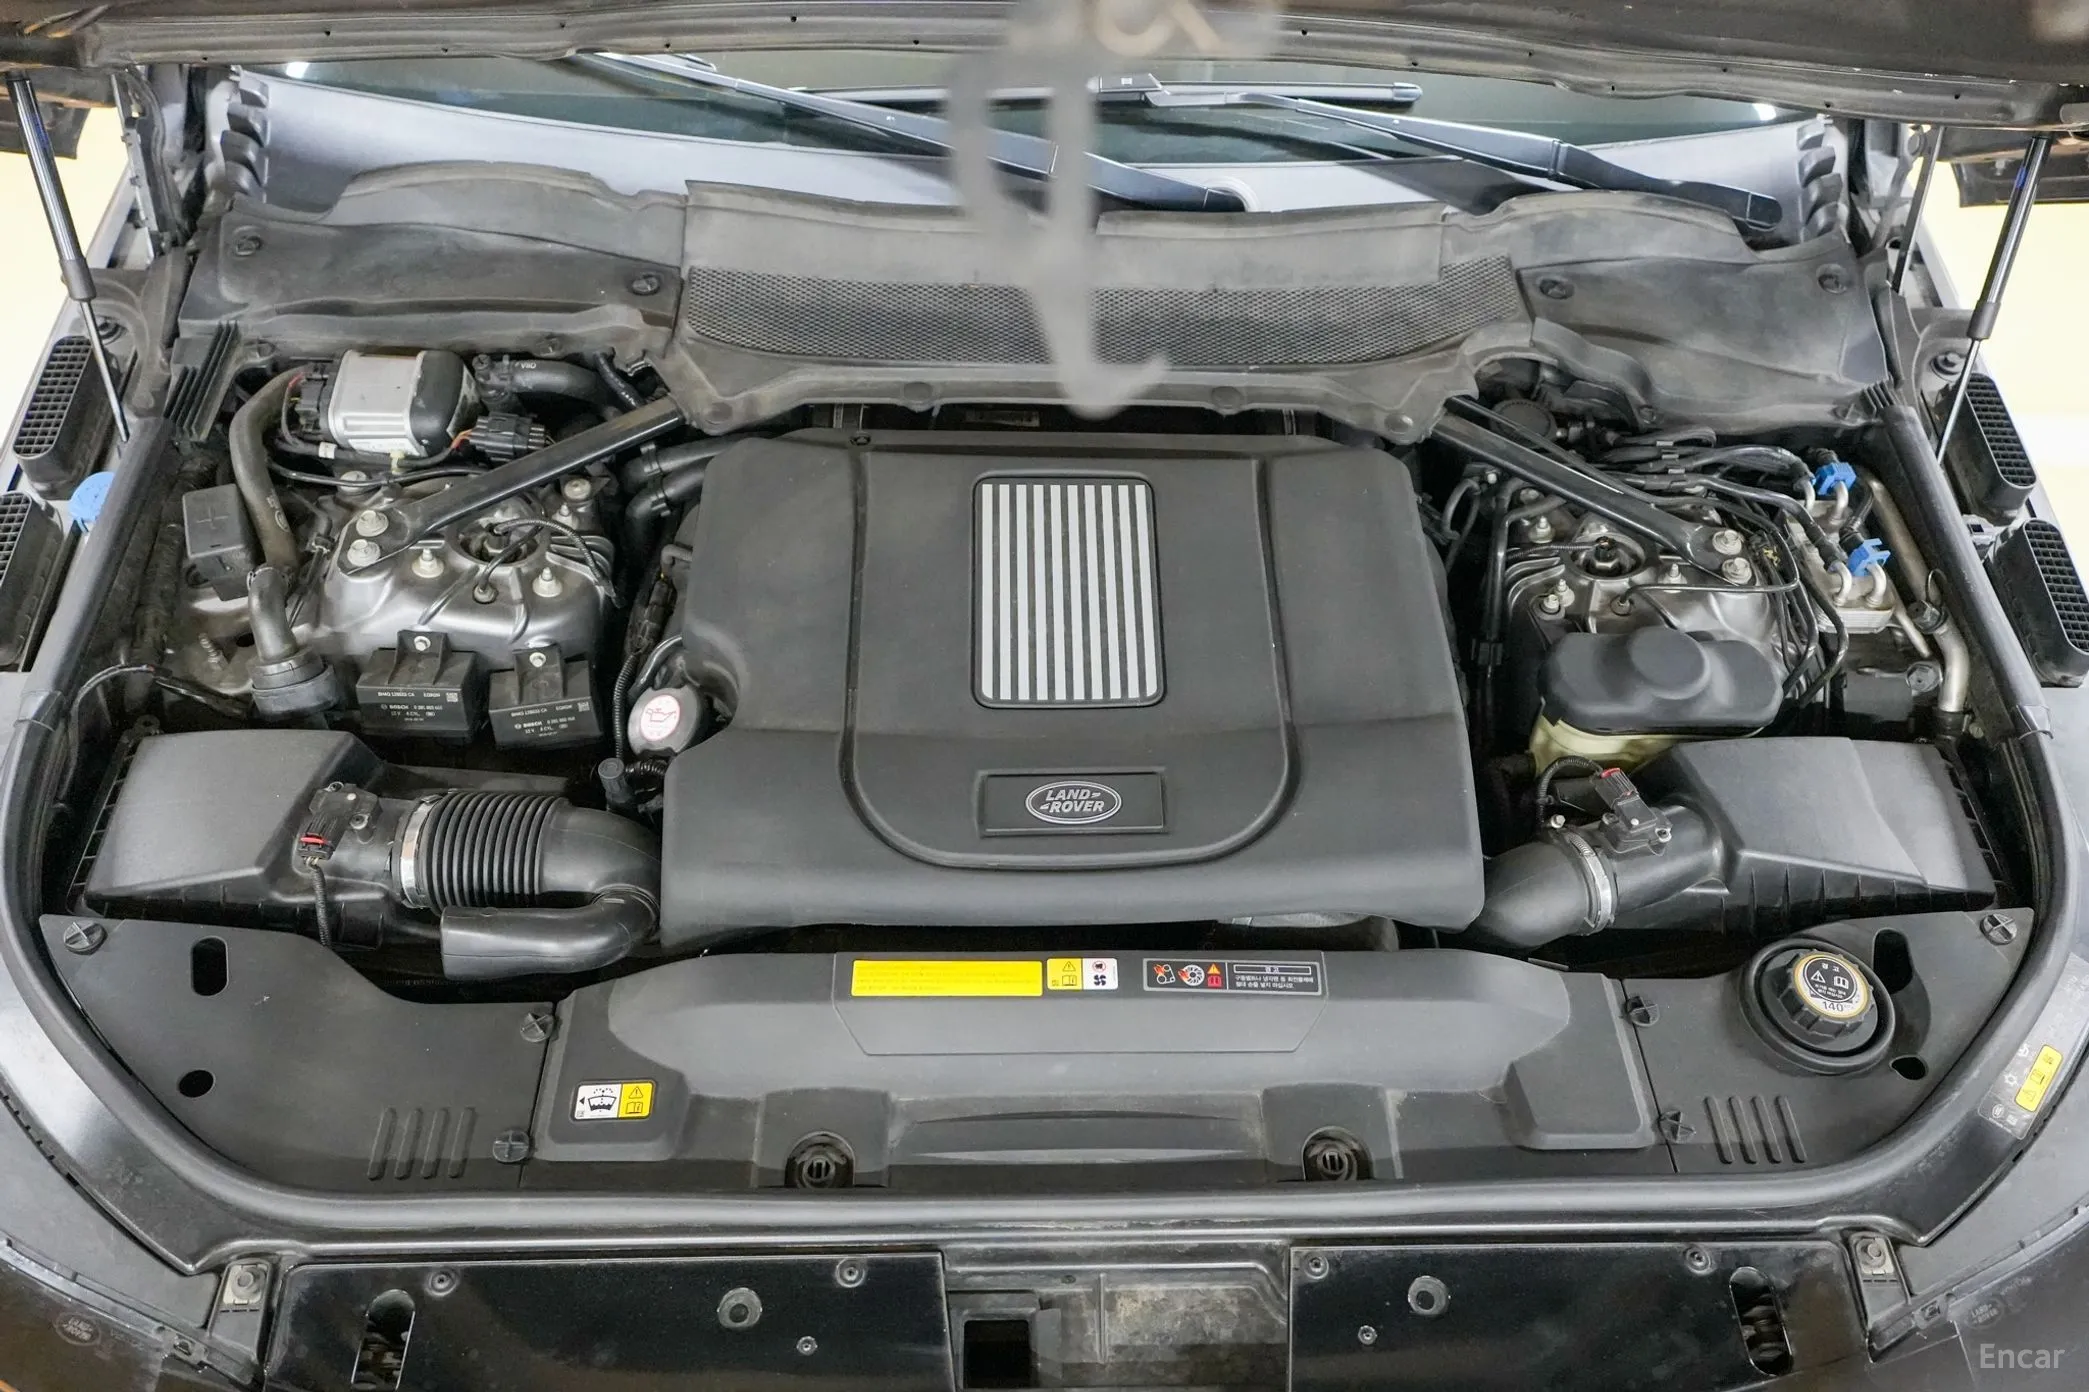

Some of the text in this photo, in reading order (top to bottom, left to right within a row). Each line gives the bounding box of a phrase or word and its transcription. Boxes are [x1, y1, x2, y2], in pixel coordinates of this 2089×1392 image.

[1045, 788, 1090, 801] LAND
[1049, 800, 1105, 813] ROVER
[1822, 1001, 1844, 1012] 140
